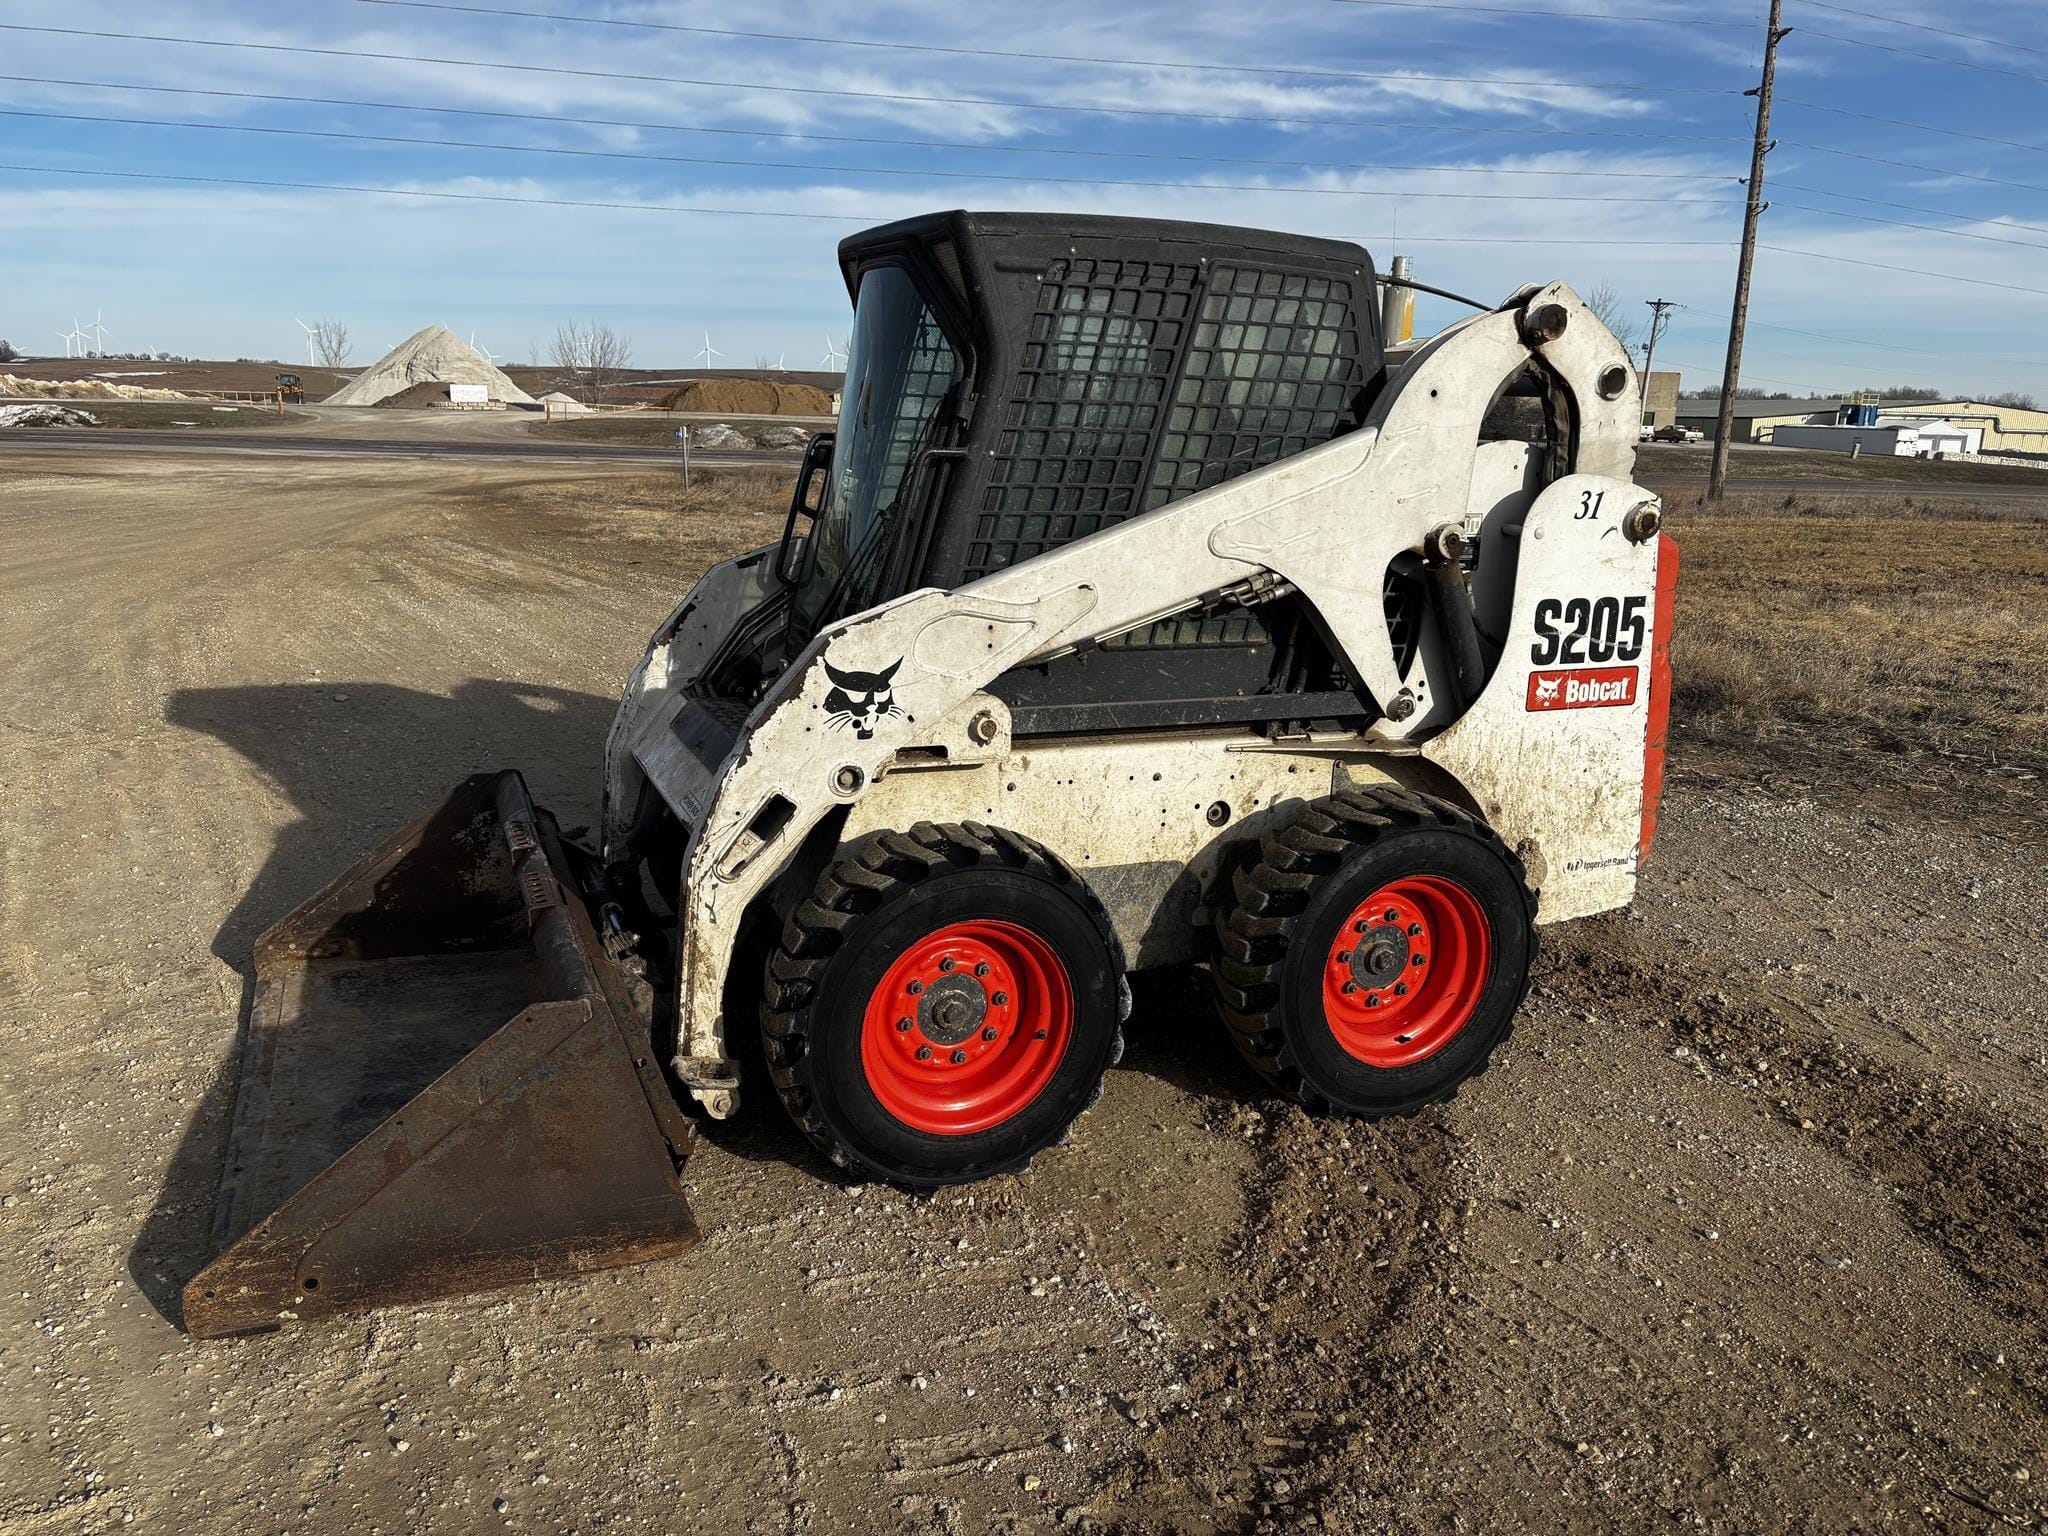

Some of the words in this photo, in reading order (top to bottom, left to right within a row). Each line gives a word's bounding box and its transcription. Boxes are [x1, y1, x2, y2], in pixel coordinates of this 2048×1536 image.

[1574, 491, 1605, 520] 31
[1531, 596, 1647, 666] S205
[1565, 677, 1631, 703] Bobcat
